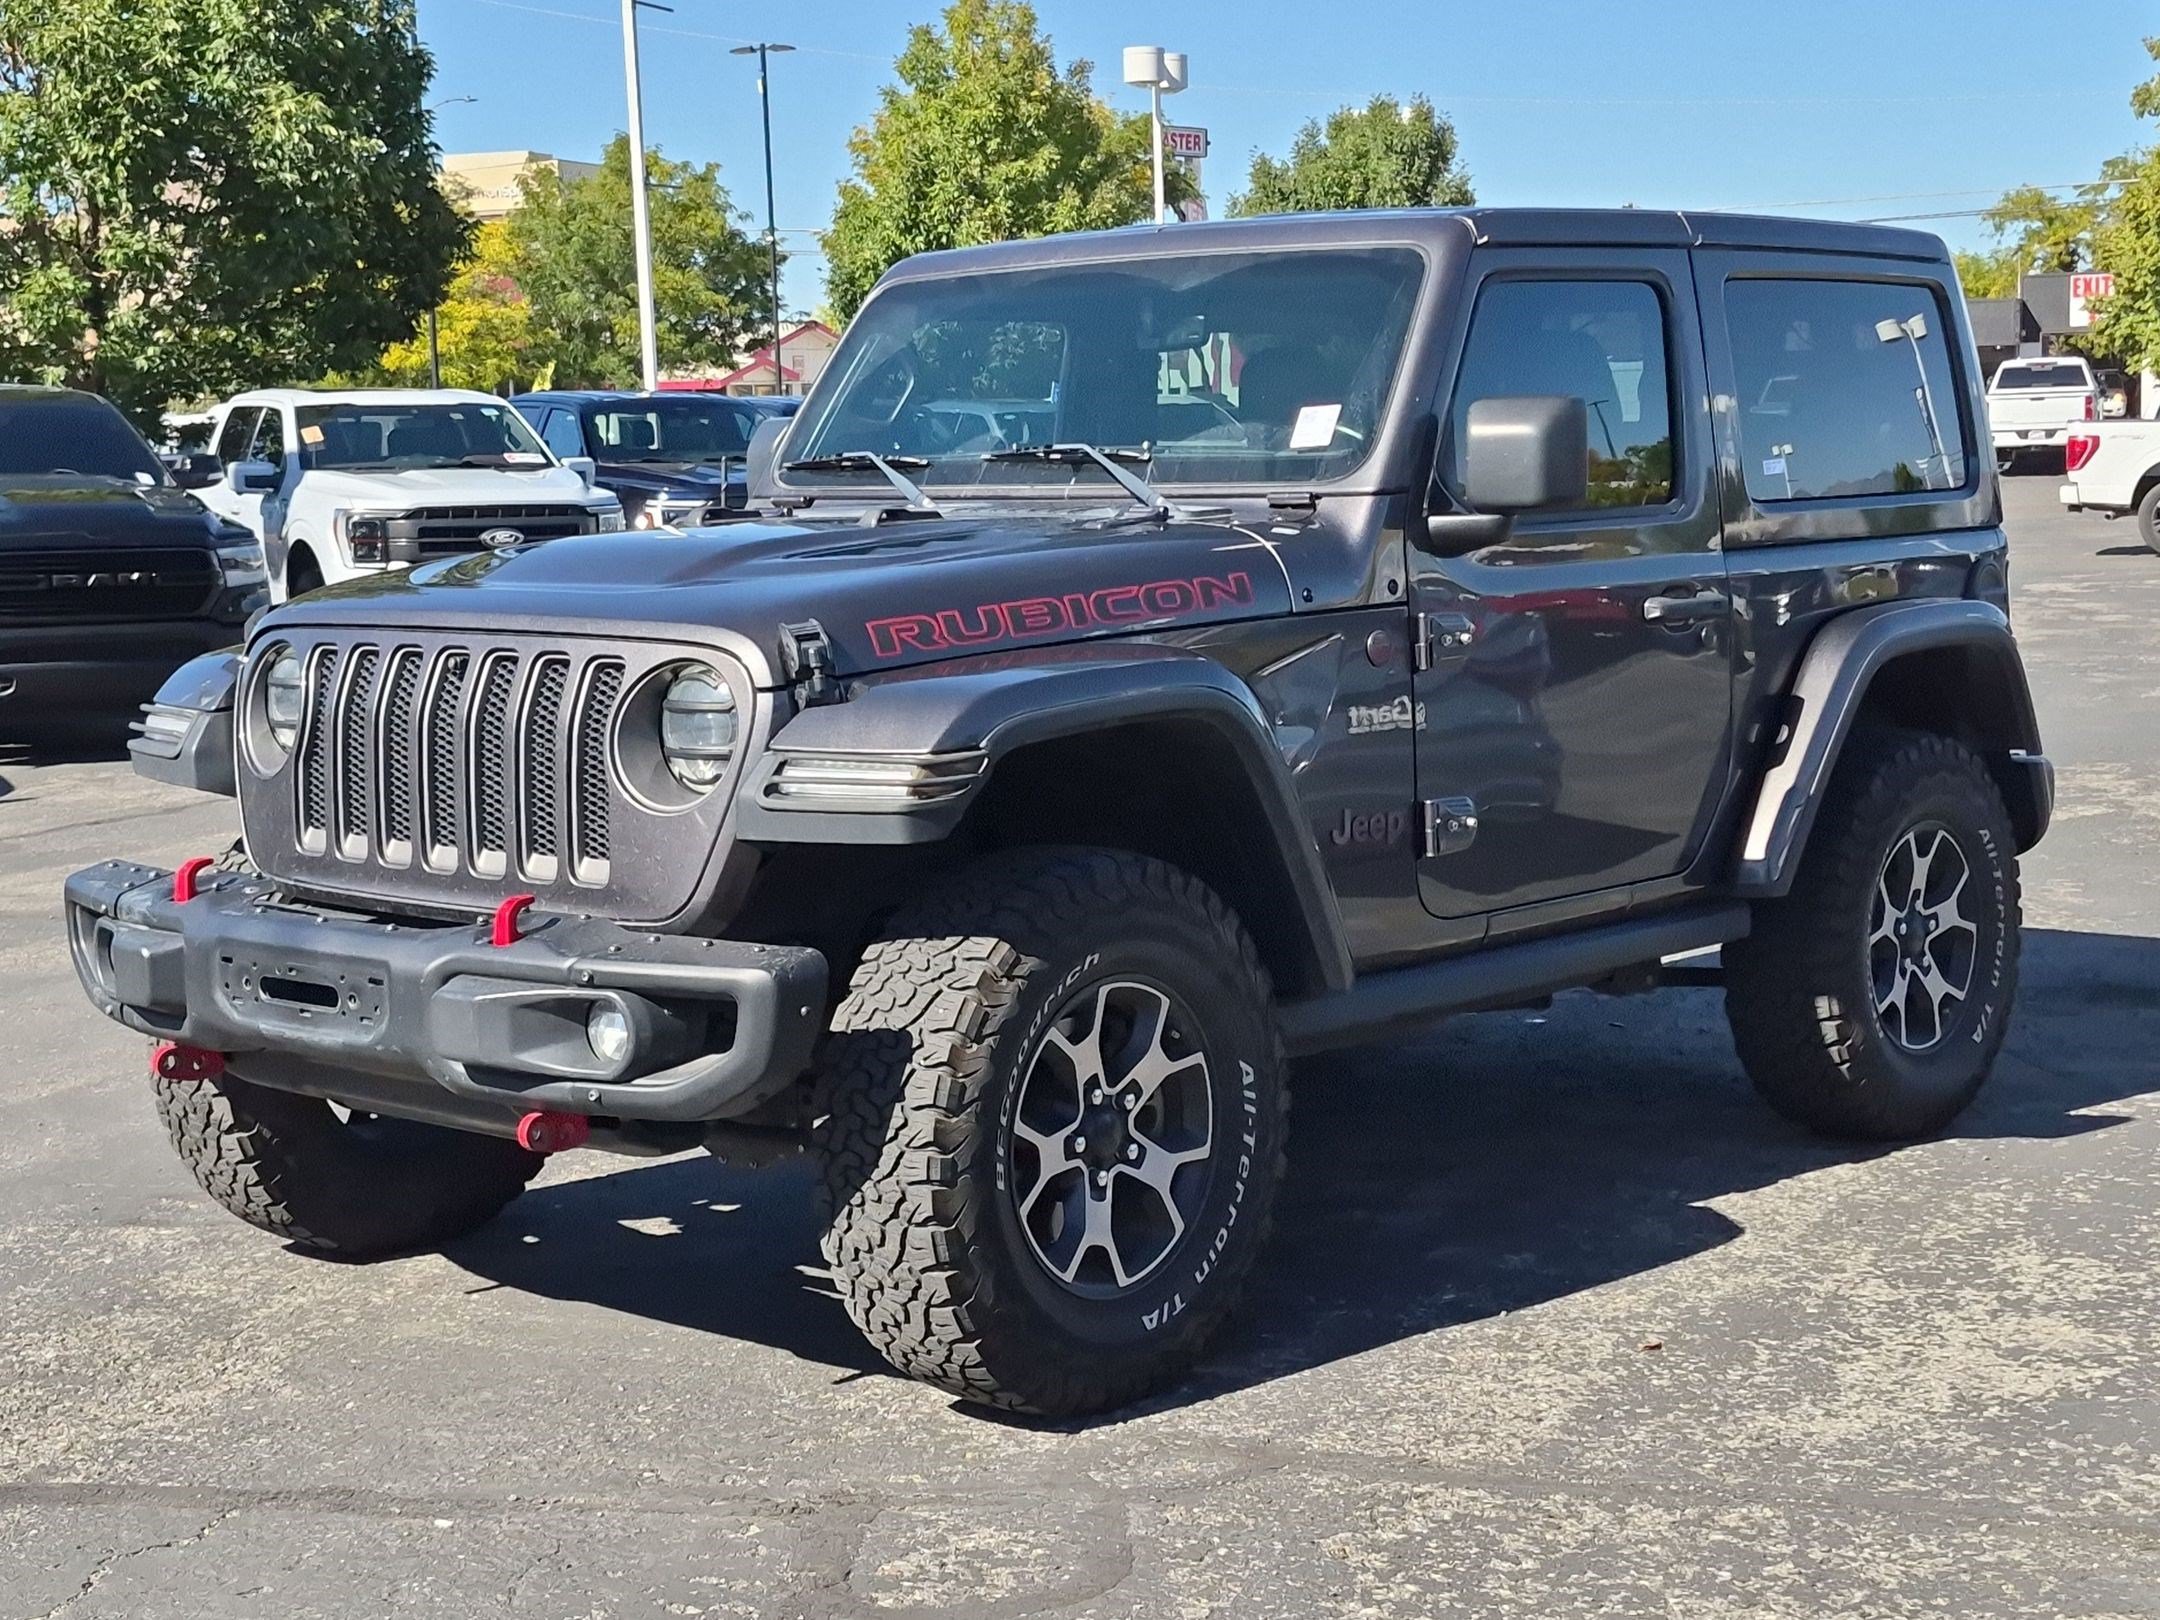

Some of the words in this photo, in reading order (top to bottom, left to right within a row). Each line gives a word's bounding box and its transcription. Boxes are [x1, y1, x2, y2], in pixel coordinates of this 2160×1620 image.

[2073, 277, 2112, 298] EXIT
[866, 572, 1254, 657] RUBICON
[1332, 808, 1403, 845] Jeep
[996, 952, 1100, 1191] BFGoodrich
[1194, 1059, 1256, 1284] All-Terrain
[1141, 1293, 1187, 1331] T/A
